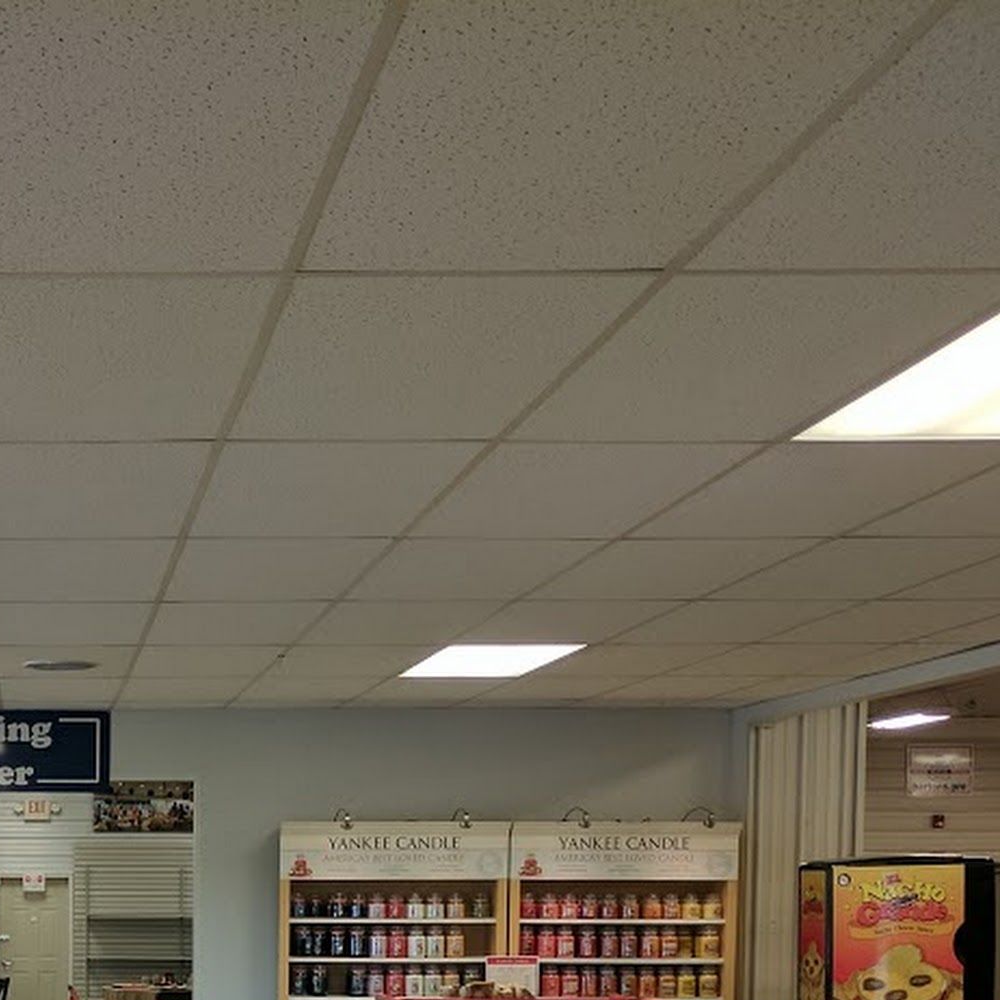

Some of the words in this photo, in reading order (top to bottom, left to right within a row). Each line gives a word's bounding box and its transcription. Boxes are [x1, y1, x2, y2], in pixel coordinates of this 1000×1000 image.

[28, 801, 46, 814] EXIT
[328, 836, 391, 850] YANKEE
[395, 836, 461, 850] CANDLE
[558, 836, 621, 850] YANKEE
[624, 836, 691, 850] CANDLE
